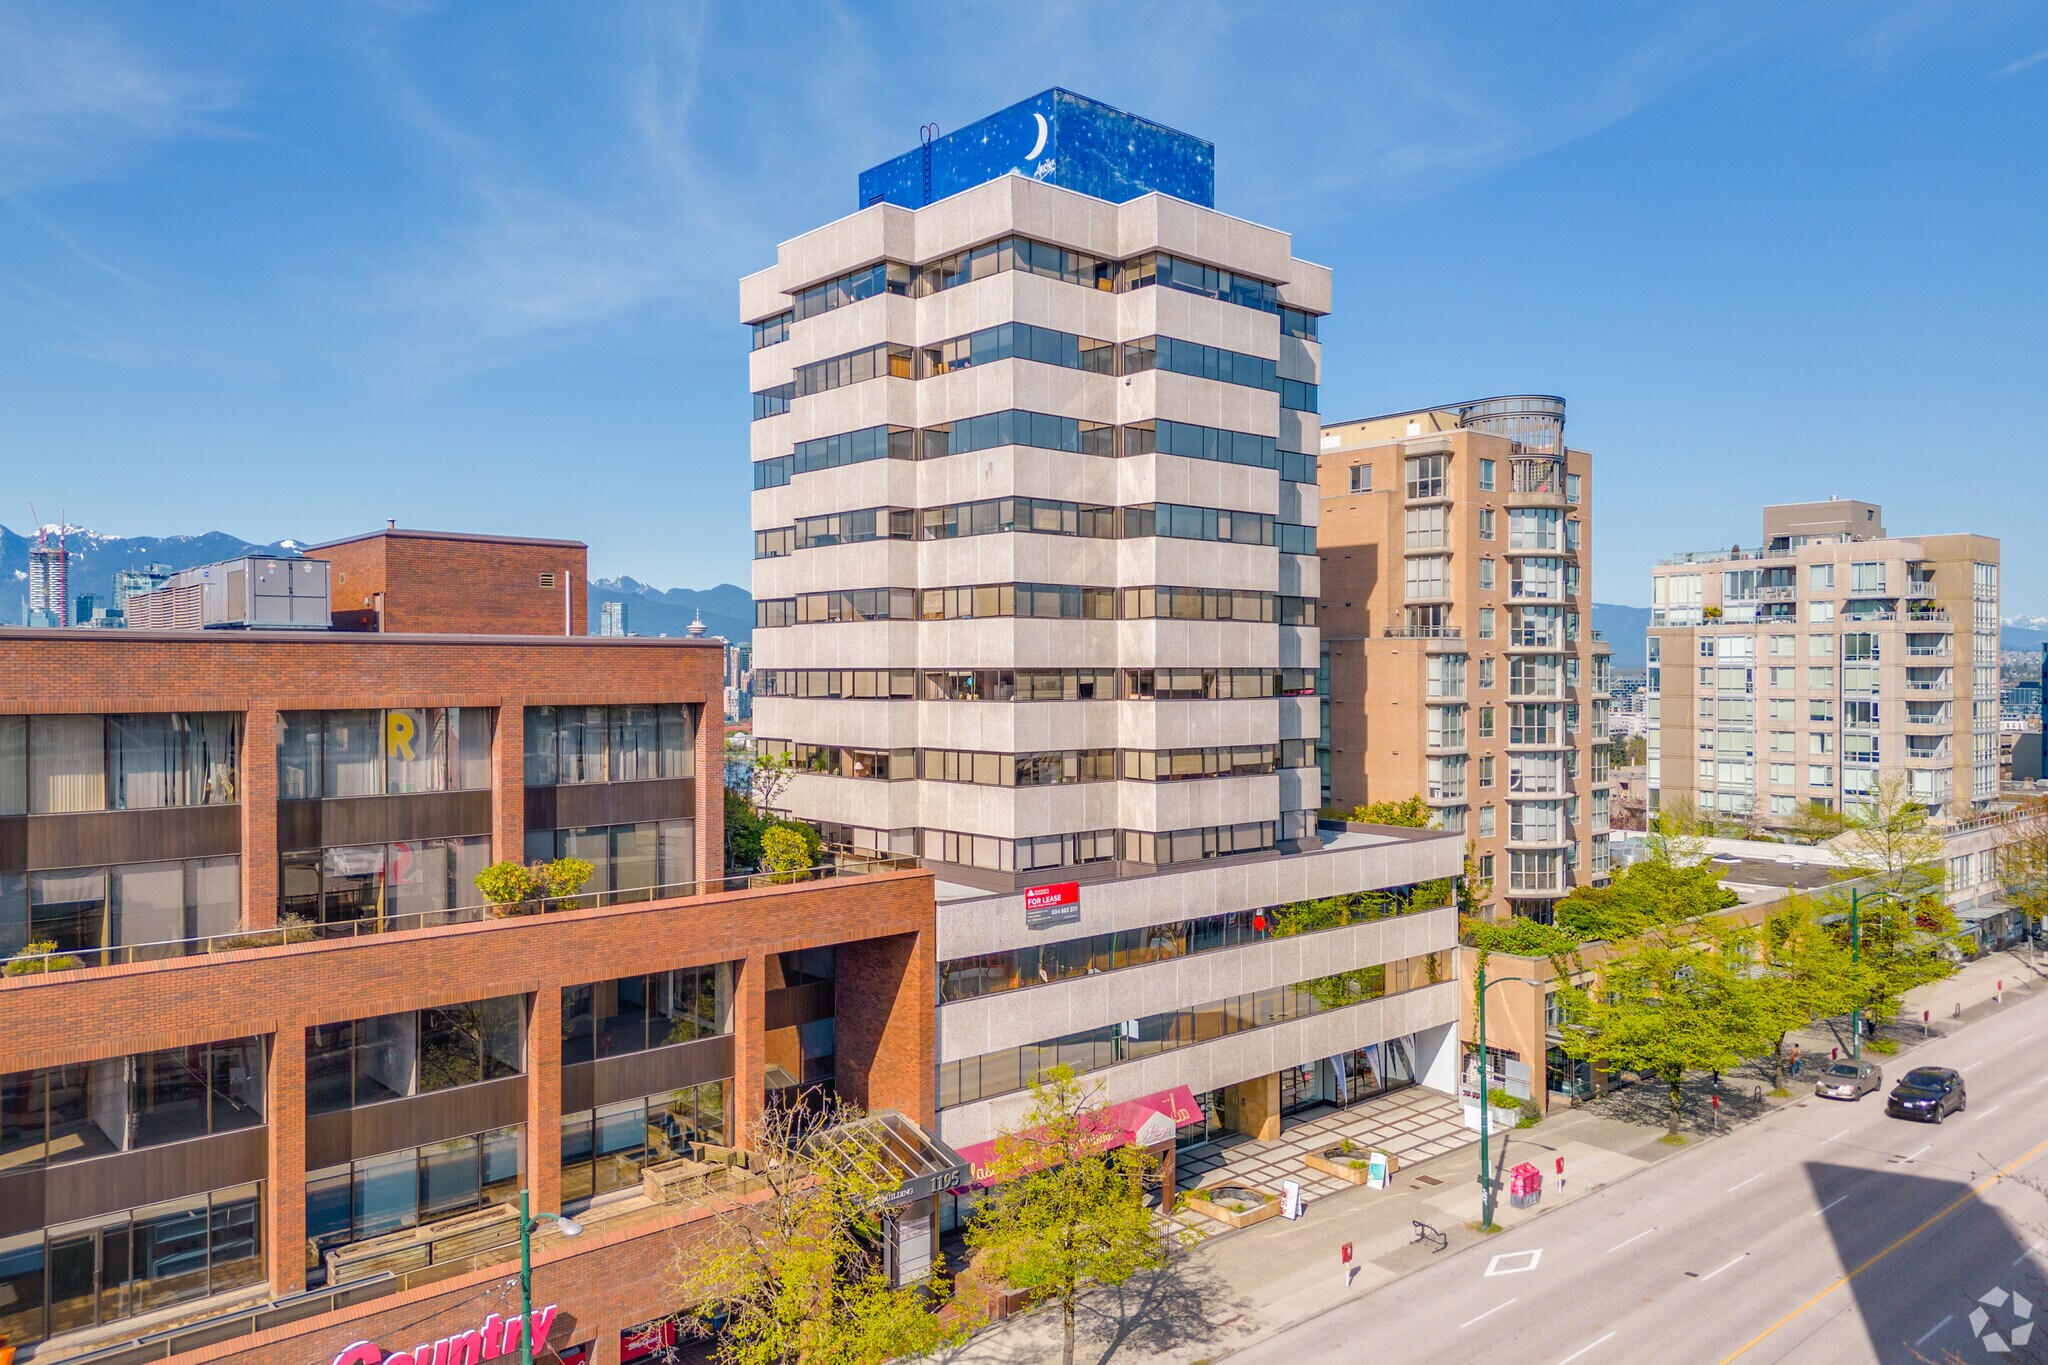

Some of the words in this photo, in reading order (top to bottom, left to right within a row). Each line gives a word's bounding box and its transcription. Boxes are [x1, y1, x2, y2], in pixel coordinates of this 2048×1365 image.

[1027, 897, 1041, 905] FOR
[1042, 894, 1061, 903] LEASE
[930, 1170, 960, 1193] 1195
